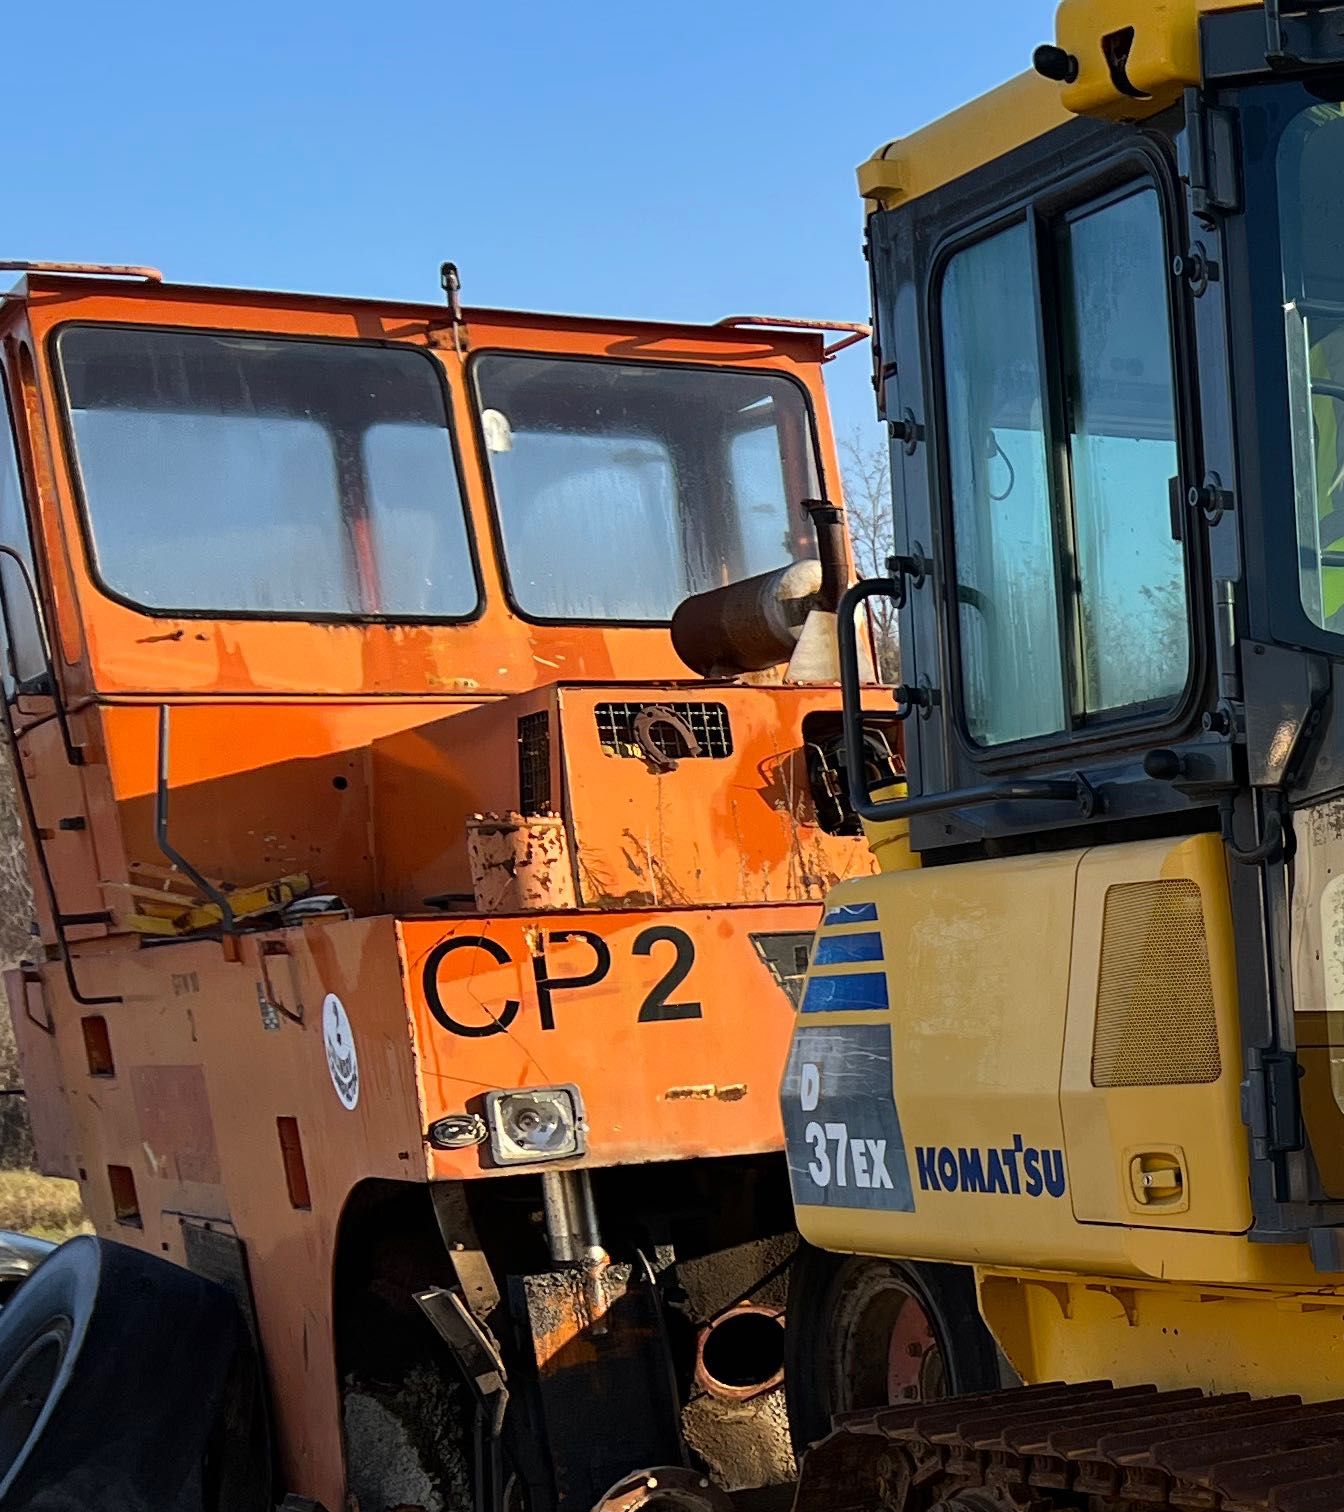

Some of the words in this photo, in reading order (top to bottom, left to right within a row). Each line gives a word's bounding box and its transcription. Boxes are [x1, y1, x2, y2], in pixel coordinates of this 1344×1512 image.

[800, 1063, 820, 1112] D
[805, 1121, 895, 1190] 37EX
[914, 1133, 1066, 1198] KOMATSU
